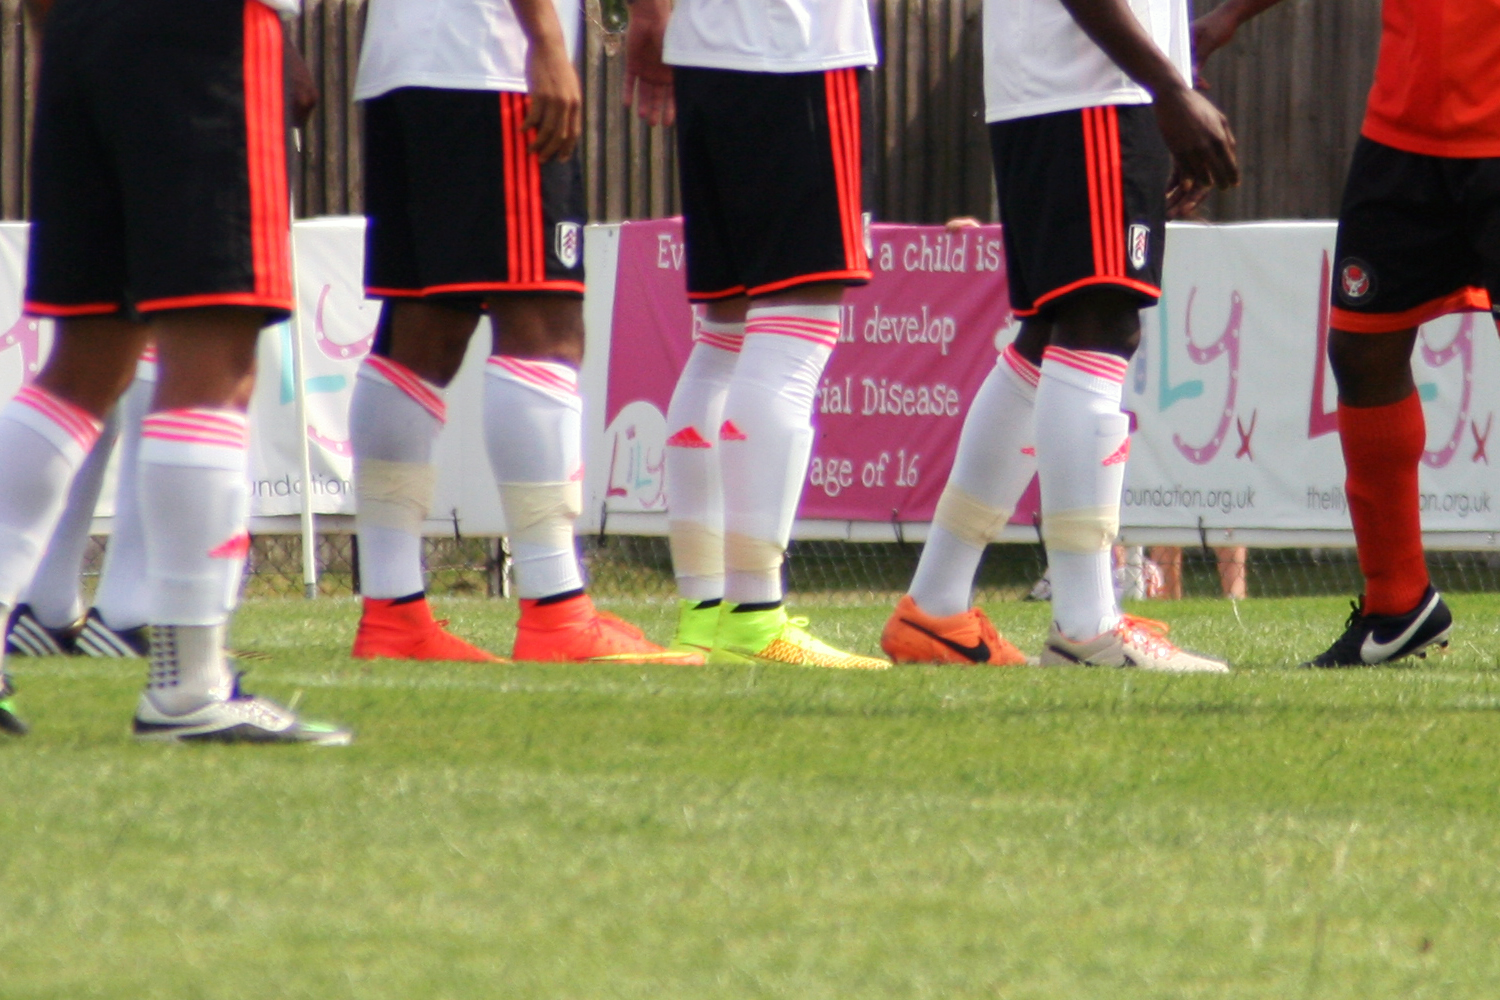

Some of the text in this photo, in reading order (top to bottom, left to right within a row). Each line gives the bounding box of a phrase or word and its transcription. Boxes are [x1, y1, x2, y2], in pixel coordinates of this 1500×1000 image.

[880, 243, 894, 271] a
[903, 234, 966, 272] child
[975, 235, 1000, 272] is
[864, 305, 956, 356] develop
[862, 378, 959, 416] Disease
[810, 450, 919, 497] age of 16
